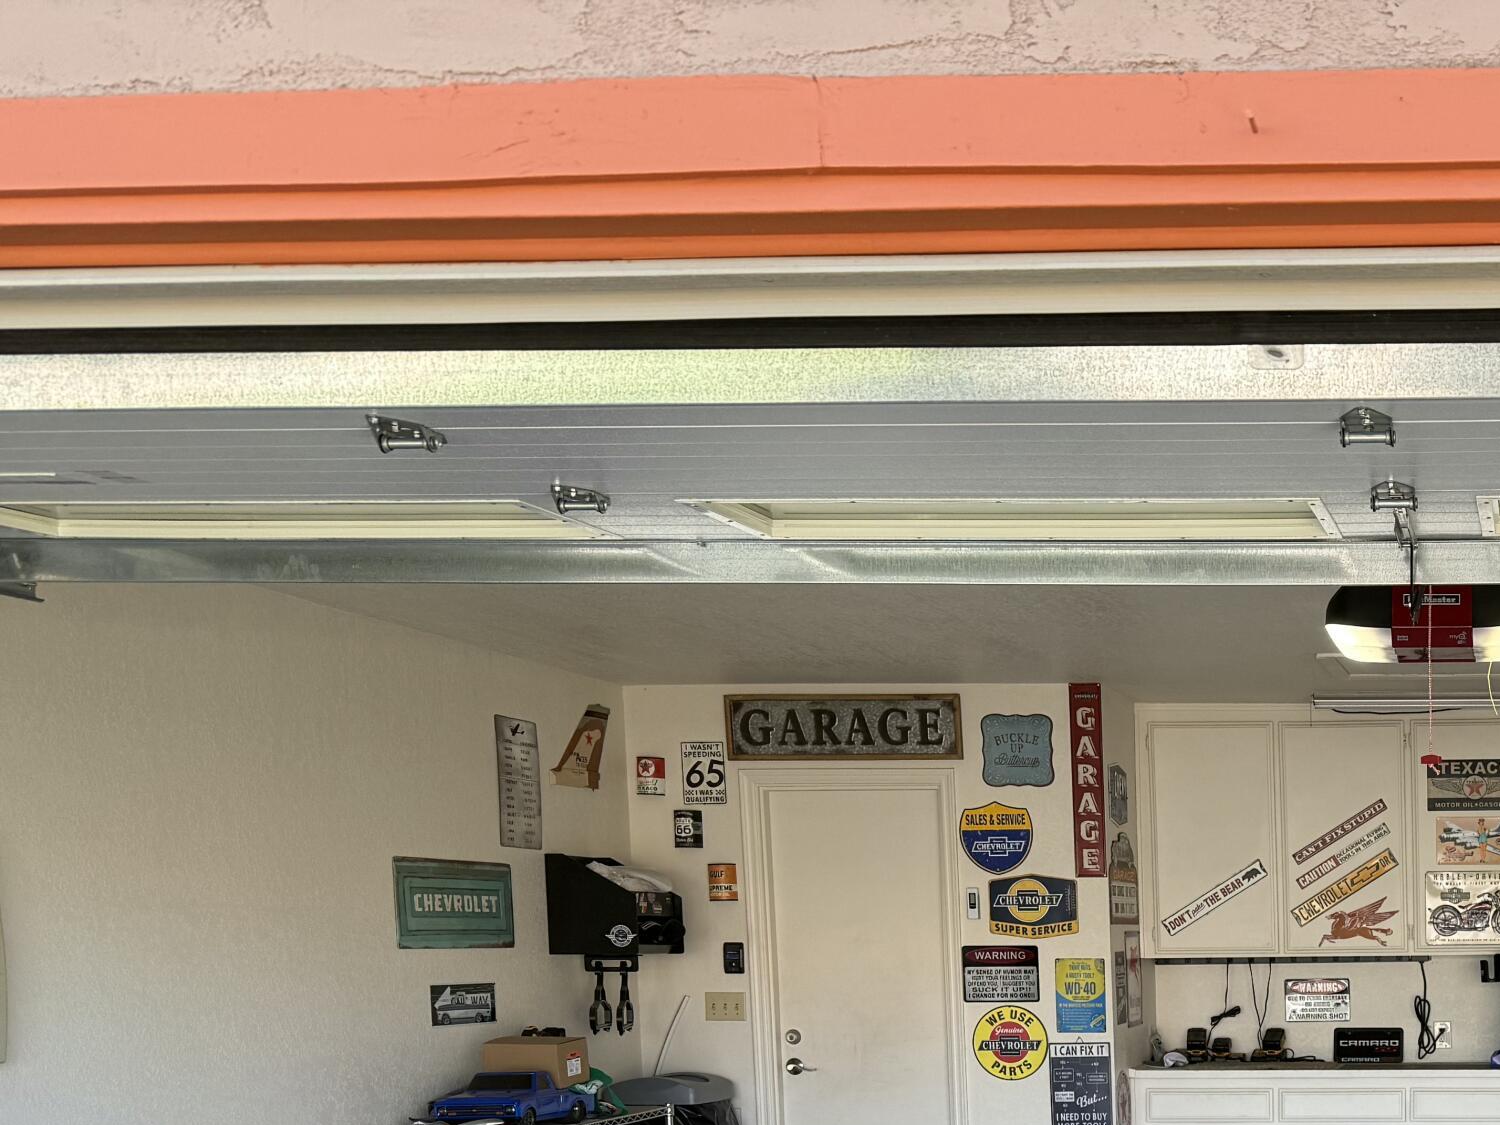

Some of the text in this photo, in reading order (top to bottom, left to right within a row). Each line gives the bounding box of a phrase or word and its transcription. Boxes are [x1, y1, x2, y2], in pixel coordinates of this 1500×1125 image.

[739, 708, 945, 747] GARAGE
[994, 732, 1040, 746] BUCKLE
[1010, 743, 1024, 754] UP
[686, 759, 725, 788] 65
[1076, 706, 1101, 872] GARAGE
[965, 813, 1026, 826] SALES & SERVICE
[676, 825, 692, 835] 66
[1295, 802, 1385, 862] CAN'T FIX STUPID
[1373, 830, 1388, 842] AREA
[976, 842, 1021, 850] CHEVROLET
[1298, 858, 1337, 888] CAUTION
[413, 893, 498, 913] CHEVROLET
[999, 895, 1058, 905] CHEVROLET
[1168, 909, 1193, 931] DON'T
[1202, 891, 1222, 908] THE
[1219, 878, 1244, 897] BEAR
[1298, 878, 1352, 921] CHEVROLET
[995, 922, 1073, 936] SUPER SERVICE
[974, 951, 1026, 960] WARNING
[1299, 982, 1338, 992] WARNING
[470, 994, 489, 1005] WAY
[985, 1009, 1034, 1028] WE USE
[994, 1026, 1025, 1036] Genuine
[982, 1040, 1039, 1050] CHEVROLET
[1059, 1045, 1078, 1056] CAN
[1080, 1045, 1094, 1056] FIX
[1097, 1045, 1105, 1055] IT
[991, 1059, 1033, 1077] PARTS
[1060, 1113, 1079, 1121] NEED
[1080, 1113, 1091, 1121] TO
[1092, 1112, 1107, 1121] BUY
